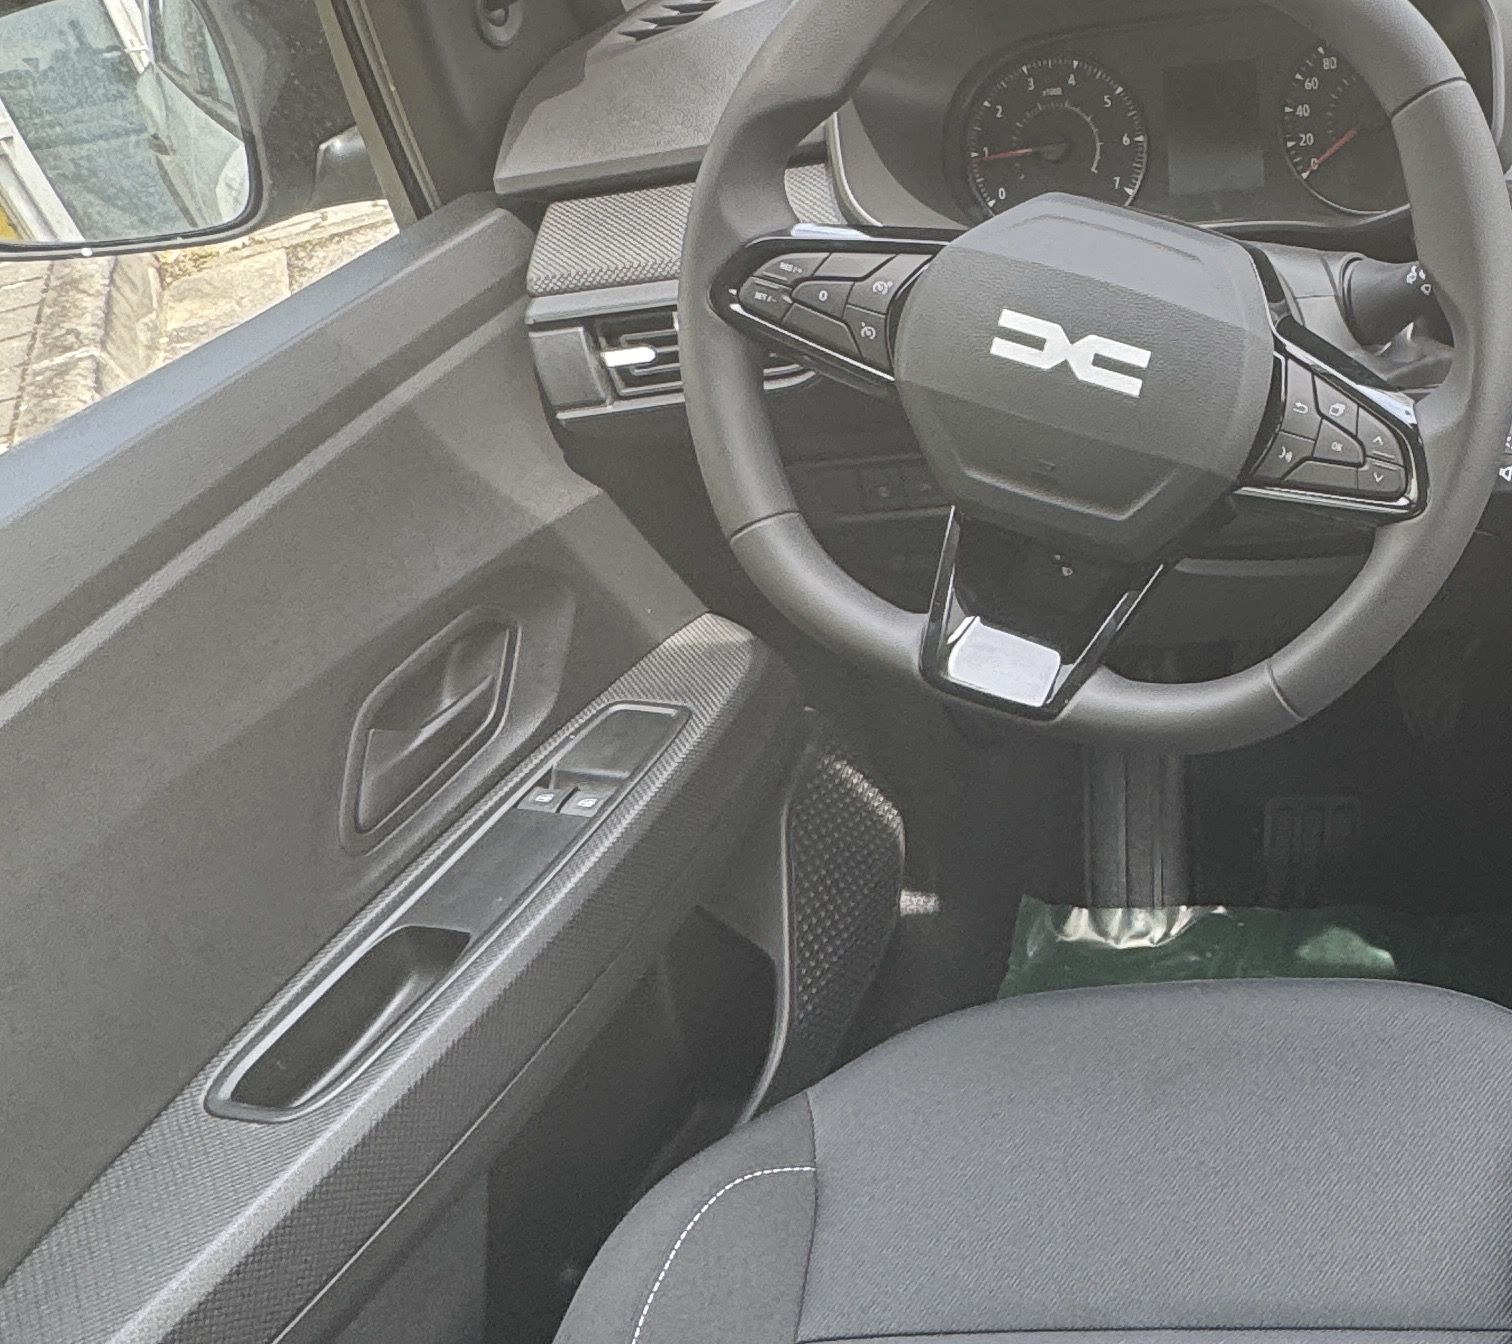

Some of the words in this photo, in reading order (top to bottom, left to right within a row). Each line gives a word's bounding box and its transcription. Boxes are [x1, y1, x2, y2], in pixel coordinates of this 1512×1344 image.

[1322, 57, 1337, 70] 80
[1027, 77, 1035, 91] 3
[1067, 74, 1076, 86] 4
[1304, 77, 1319, 90] 60
[1103, 95, 1112, 108] 5
[996, 105, 1003, 118] 2
[1295, 104, 1310, 117] 40
[1122, 133, 1131, 146] 6
[1299, 133, 1314, 146] 20
[1113, 176, 1121, 190] 7
[998, 187, 1006, 200] 0
